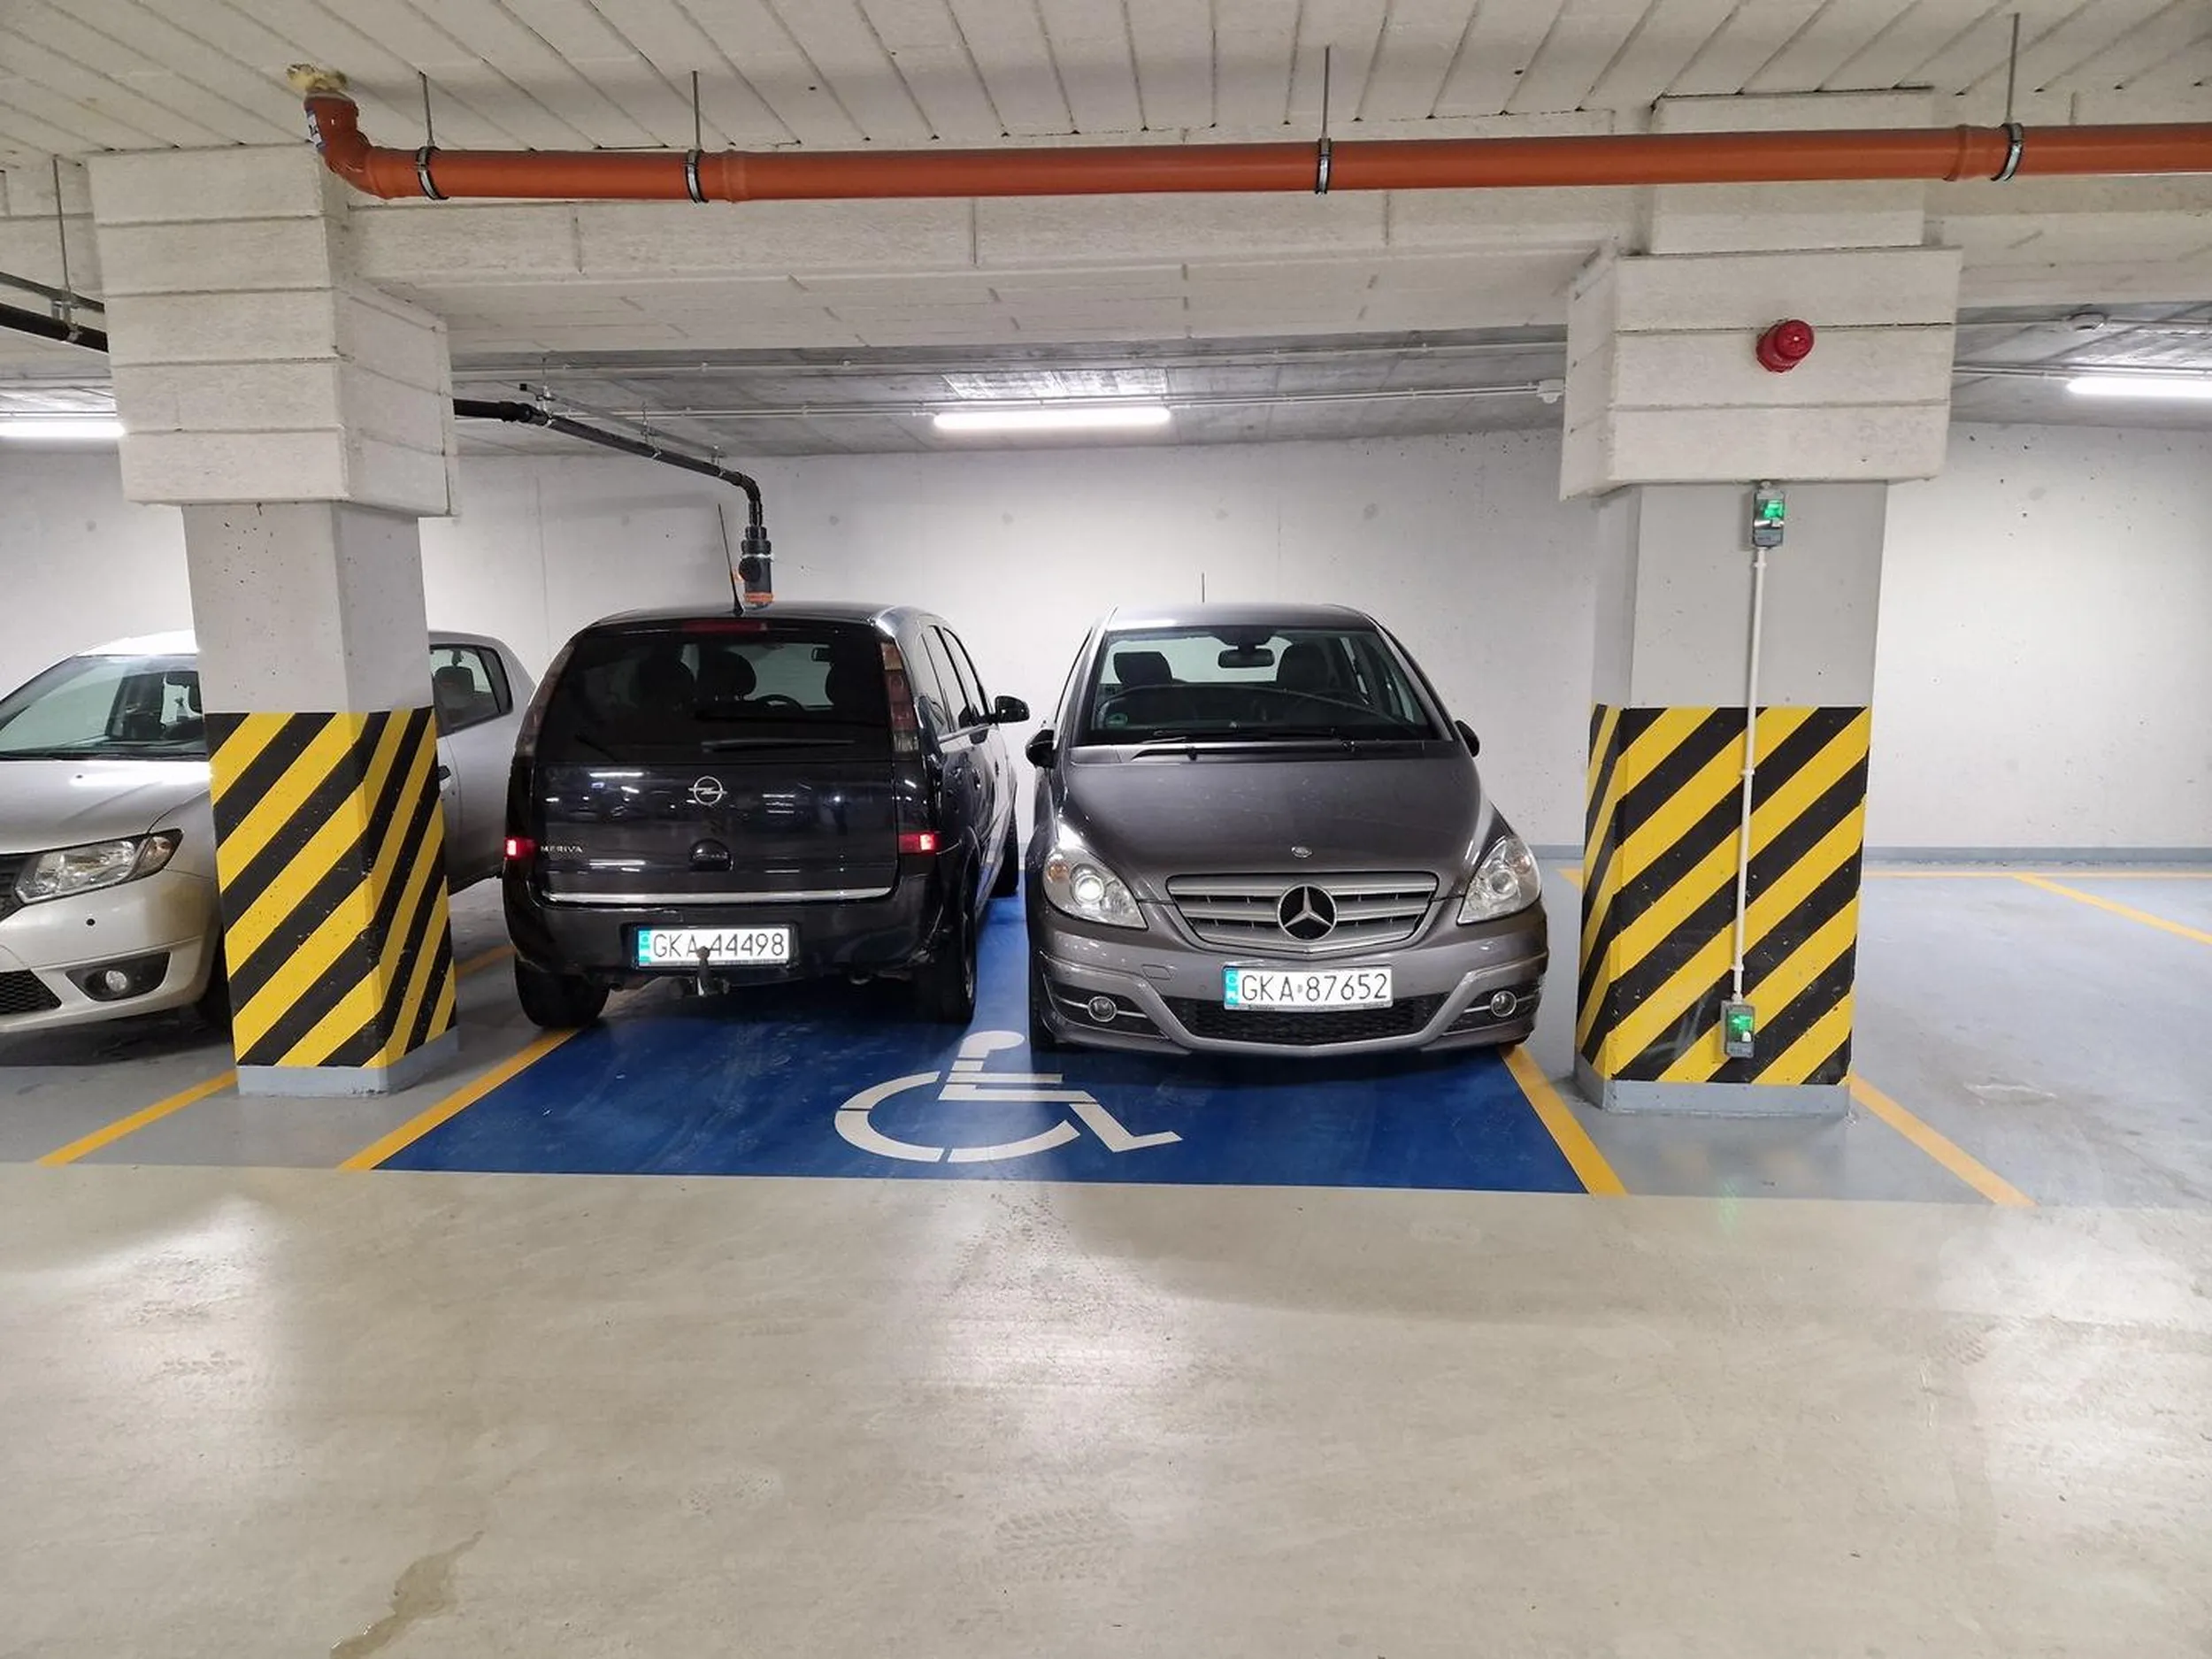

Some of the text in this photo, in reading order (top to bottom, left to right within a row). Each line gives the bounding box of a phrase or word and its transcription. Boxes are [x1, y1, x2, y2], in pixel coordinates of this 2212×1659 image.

[653, 932, 785, 958] GKA 44498
[1241, 973, 1388, 1002] GKA 87652
